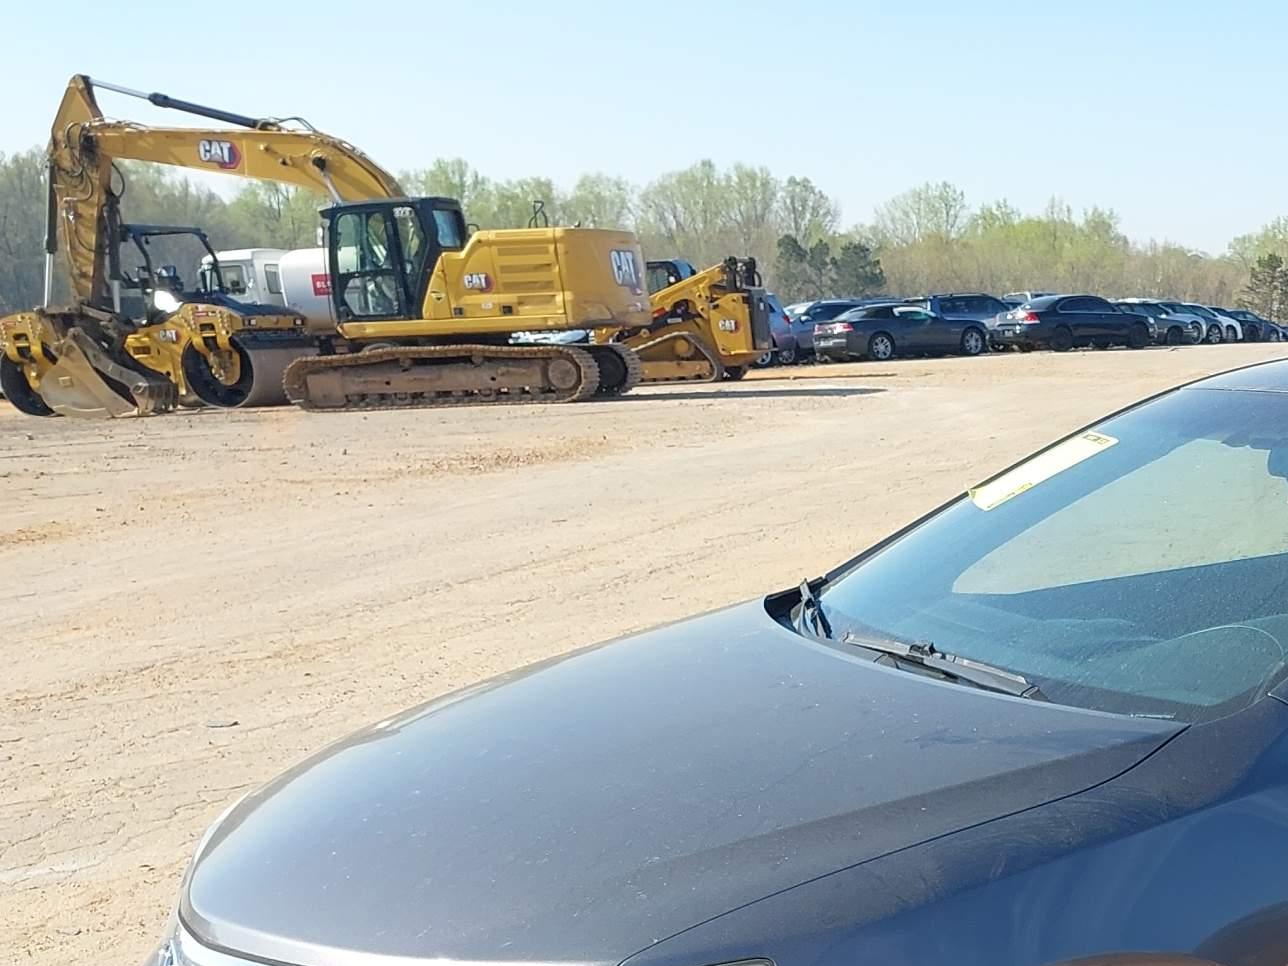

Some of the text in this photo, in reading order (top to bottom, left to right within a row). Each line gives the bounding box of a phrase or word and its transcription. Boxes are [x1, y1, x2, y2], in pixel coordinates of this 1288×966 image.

[199, 140, 230, 162] CAT
[611, 250, 637, 285] CAT
[464, 274, 486, 289] CAT
[719, 319, 736, 331] CAT
[160, 329, 177, 341] CAT
